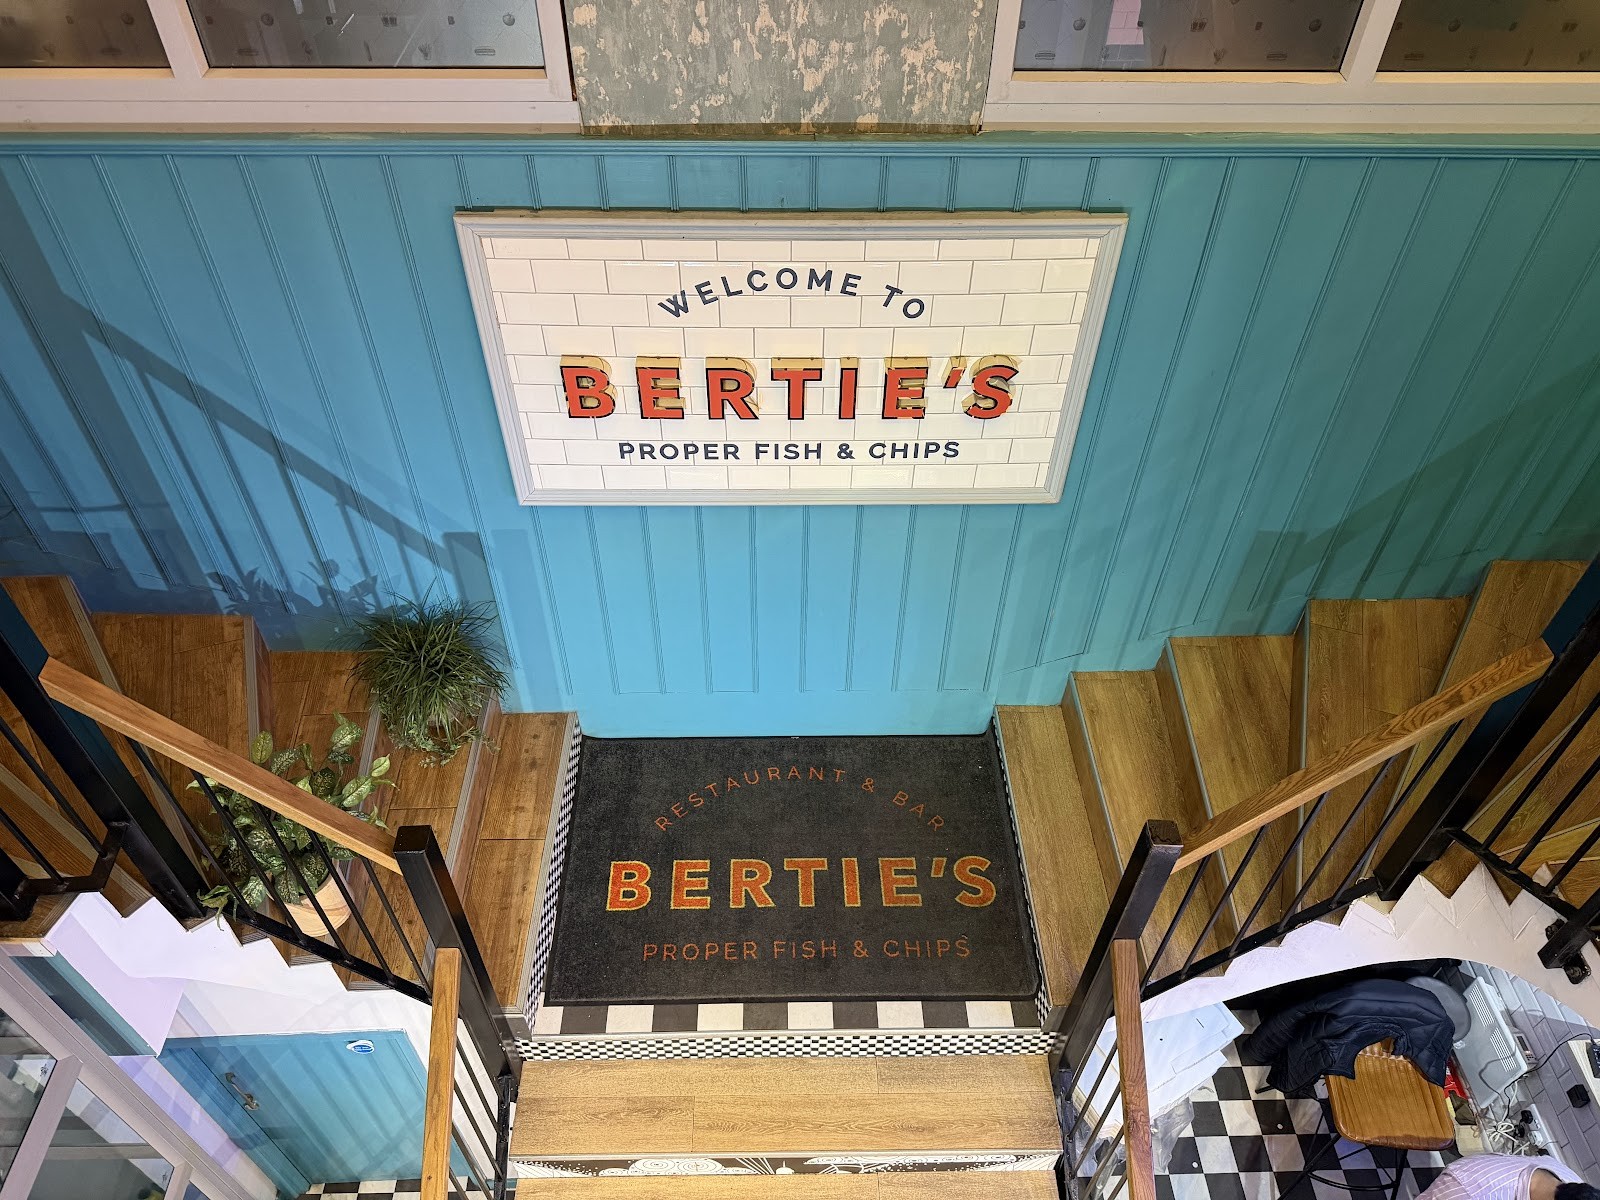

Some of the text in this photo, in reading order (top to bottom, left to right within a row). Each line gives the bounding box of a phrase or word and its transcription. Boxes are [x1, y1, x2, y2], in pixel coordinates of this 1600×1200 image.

[657, 267, 926, 320] WELCOME TO
[559, 354, 1021, 421] BERTIE'S
[618, 441, 961, 461] PROPER FISH & CHIPS
[653, 765, 945, 833] RESTAURANT & BAR
[605, 855, 998, 912] BERTIE'S
[642, 939, 973, 961] PROPER FISH & CHIPS
